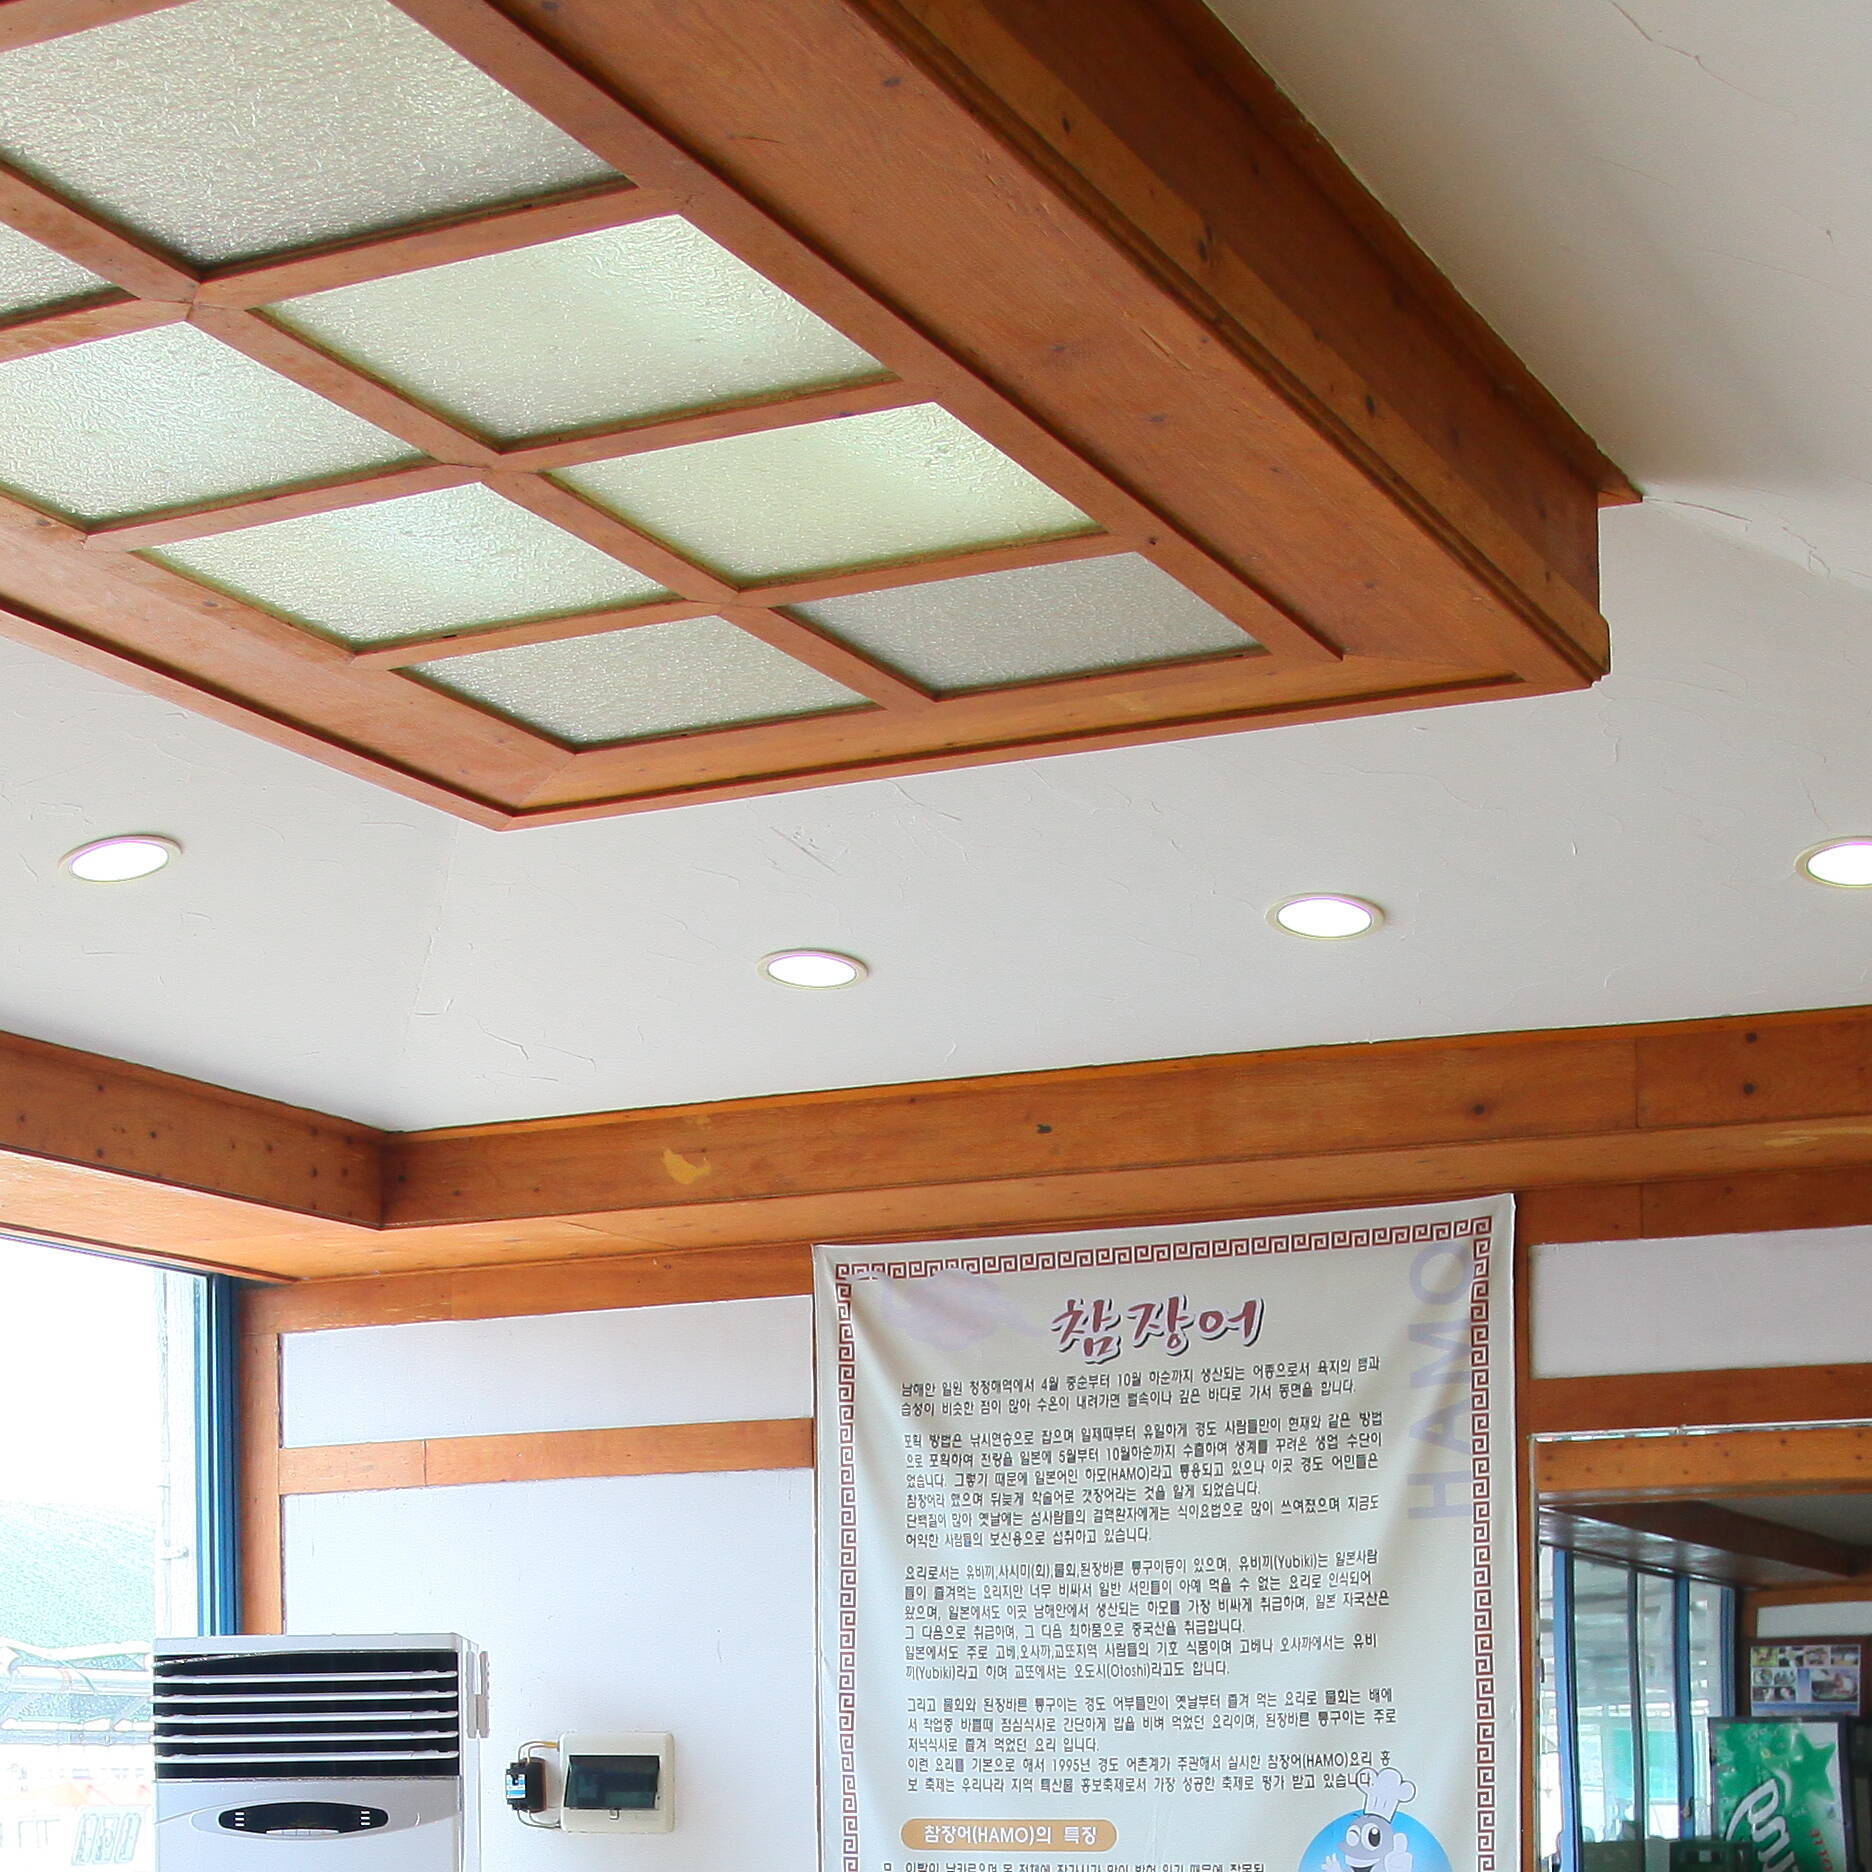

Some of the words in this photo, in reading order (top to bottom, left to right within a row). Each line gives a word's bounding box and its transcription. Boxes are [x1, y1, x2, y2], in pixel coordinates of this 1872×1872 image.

[1051, 1294, 1264, 1363] 참장어
[1065, 1373, 1110, 1390] 중순부터
[1117, 1371, 1142, 1387] 10월
[1199, 1365, 1245, 1382] 생산되는
[1252, 1361, 1310, 1379] 어종으로서
[1407, 1242, 1474, 1520] HAMO
[900, 1401, 935, 1417] 습성이
[1036, 1396, 1069, 1412] 수온이
[1075, 1393, 1120, 1410] 내려가면
[1207, 1386, 1242, 1403] 바다로
[928, 1433, 963, 1448] 방법은
[1041, 1428, 1074, 1444] 잡으며
[1080, 1425, 1136, 1442] 일제때부터
[1194, 1420, 1217, 1436] 경도
[1019, 1450, 1052, 1465] 일본에
[1058, 1448, 1099, 1464] 5월부터
[1275, 1437, 1308, 1453] 꾸려온
[1346, 1433, 1381, 1449] 수단이
[994, 1471, 1028, 1486] 때문에
[1034, 1469, 1078, 1485] 일본어인
[1230, 1460, 1265, 1477] 있으나
[1270, 1459, 1293, 1474] 이곳
[906, 1493, 945, 1509] 참장어라
[1172, 1483, 1195, 1499] 알게
[906, 1513, 947, 1529] 단백질이
[951, 1512, 972, 1528] 많아
[977, 1511, 1023, 1527] 옛날에는
[1347, 1495, 1379, 1511] 지금도
[989, 1530, 1045, 1546] 보신용으로
[904, 1565, 960, 1581] 요리로서는
[1335, 1550, 1378, 1566] 일본사람
[983, 1584, 1023, 1599] 요리지만
[1058, 1582, 1092, 1598] 비싸서
[1328, 1571, 1371, 1587] 인식되어
[947, 1605, 1001, 1620] 일본에서도
[1095, 1602, 1140, 1618] 생산되는
[1342, 1591, 1390, 1608] 자국산은
[904, 1625, 915, 1640] 그
[921, 1625, 966, 1640] 다음으로
[1040, 1624, 1063, 1639] 다음
[904, 1645, 959, 1660] 일본에서도
[966, 1645, 988, 1659] 주로
[1352, 1634, 1376, 1649] 유비
[906, 1698, 936, 1713] 그리고
[983, 1697, 1028, 1712] 된장바른
[1174, 1693, 1221, 1709] 옛날부터
[922, 1717, 953, 1732] 작업중
[1000, 1717, 1056, 1732] 점심식사로
[1265, 1711, 1310, 1727] 된장바른
[907, 1738, 958, 1752] 저녁식사로
[993, 1738, 1027, 1752] 먹었던
[1033, 1738, 1056, 1752] 요리
[971, 1757, 1015, 1772] 기본으로
[1052, 1757, 1091, 1772] 1995년
[1125, 1756, 1171, 1771] 어촌계가
[924, 1778, 955, 1793] 축제는
[961, 1778, 1004, 1793] 우리나라
[1221, 1775, 1254, 1790] 축제로
[924, 1825, 1052, 1846] 참장어(HAMO)의
[1064, 1826, 1097, 1845] 특징
